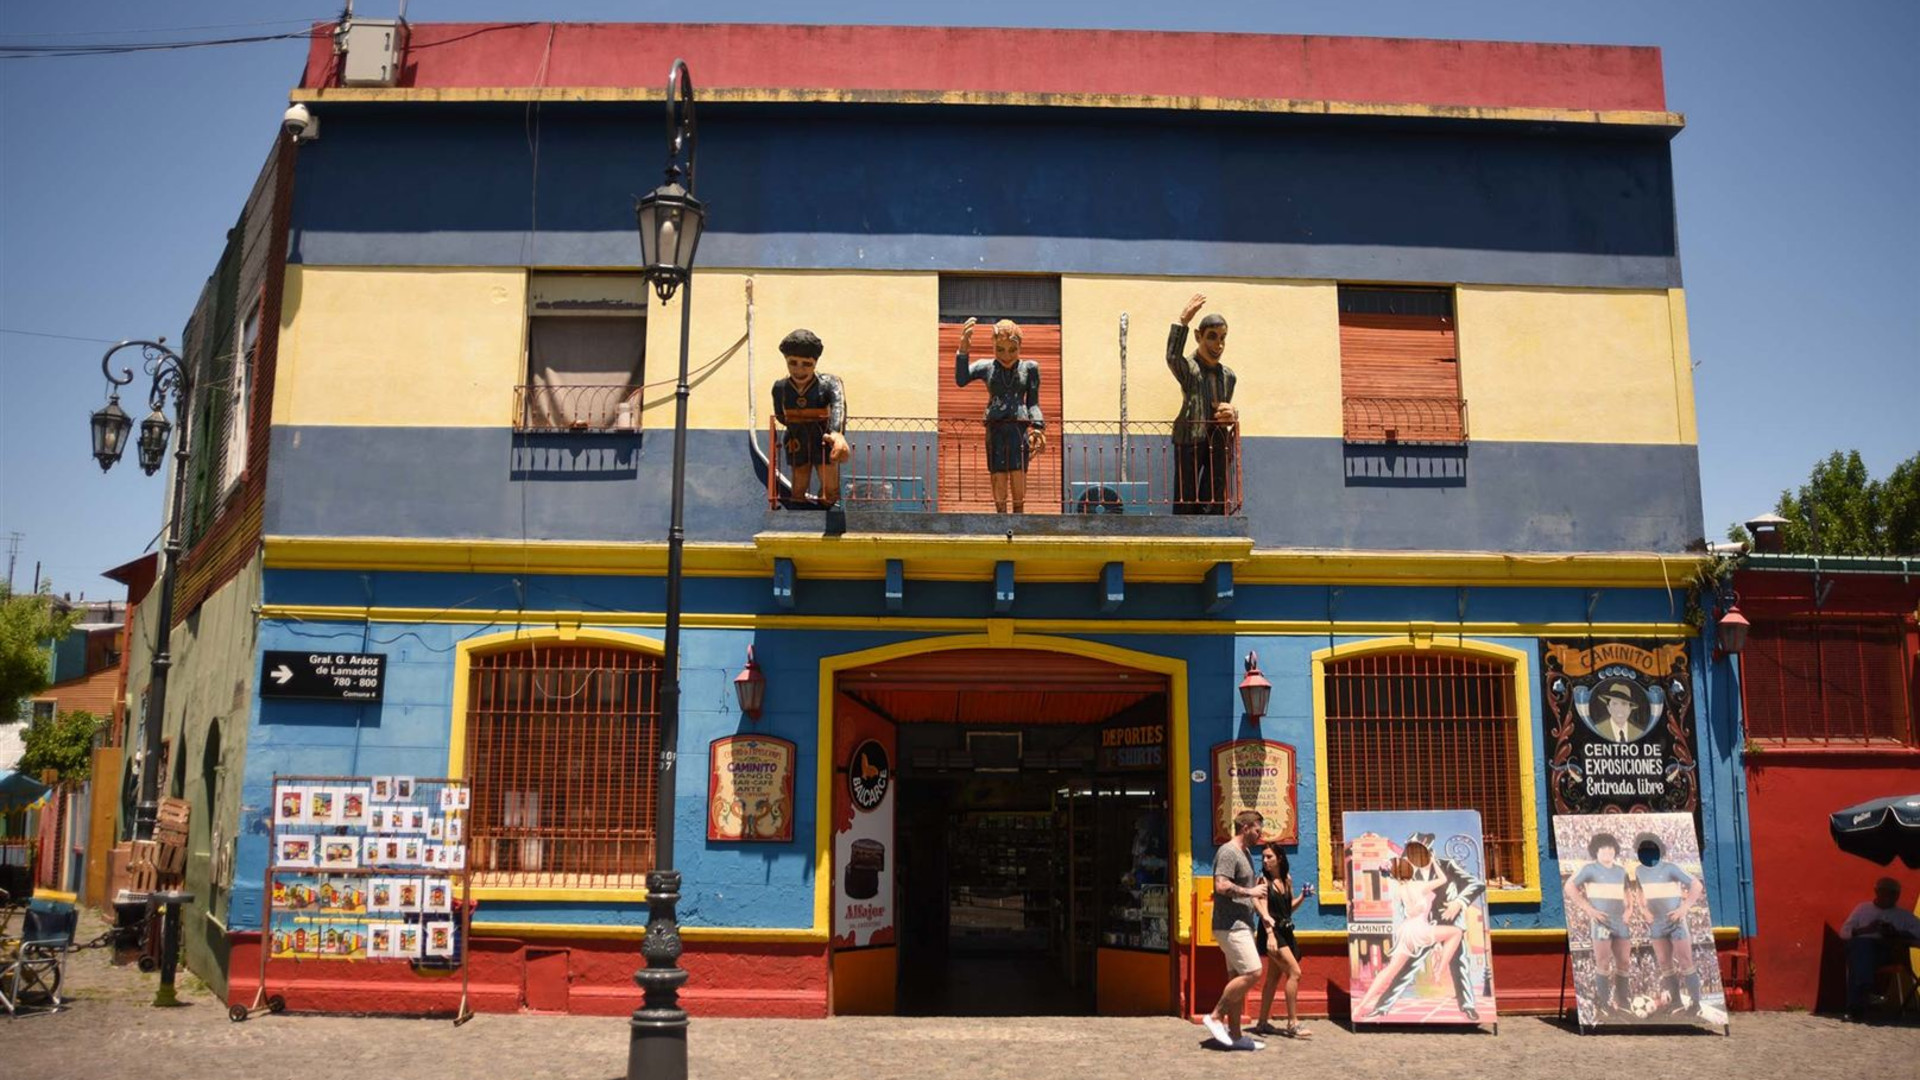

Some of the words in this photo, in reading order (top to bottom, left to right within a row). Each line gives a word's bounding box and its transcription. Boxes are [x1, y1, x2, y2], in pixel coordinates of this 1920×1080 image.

[309, 654, 333, 664] Gral.
[335, 655, 347, 665] G.
[1580, 646, 1653, 669] CAMINITO
[316, 666, 328, 675] de
[330, 666, 378, 676] Lamadrid
[333, 677, 350, 686] 780
[358, 678, 377, 688] 800
[1102, 725, 1163, 746] DEPORTES
[1584, 743, 1639, 756] CENTRO
[1643, 743, 1662, 756] DE
[727, 762, 777, 772] CAMINITO
[1228, 767, 1278, 777] CAMINITO
[1585, 759, 1663, 775] EXPOSICIONES
[852, 769, 887, 806] BALCARCE
[1586, 776, 1636, 796] Entrada
[1637, 778, 1665, 795] libre
[845, 903, 885, 920] Alfajor
[1350, 924, 1393, 933] CAMINITO
